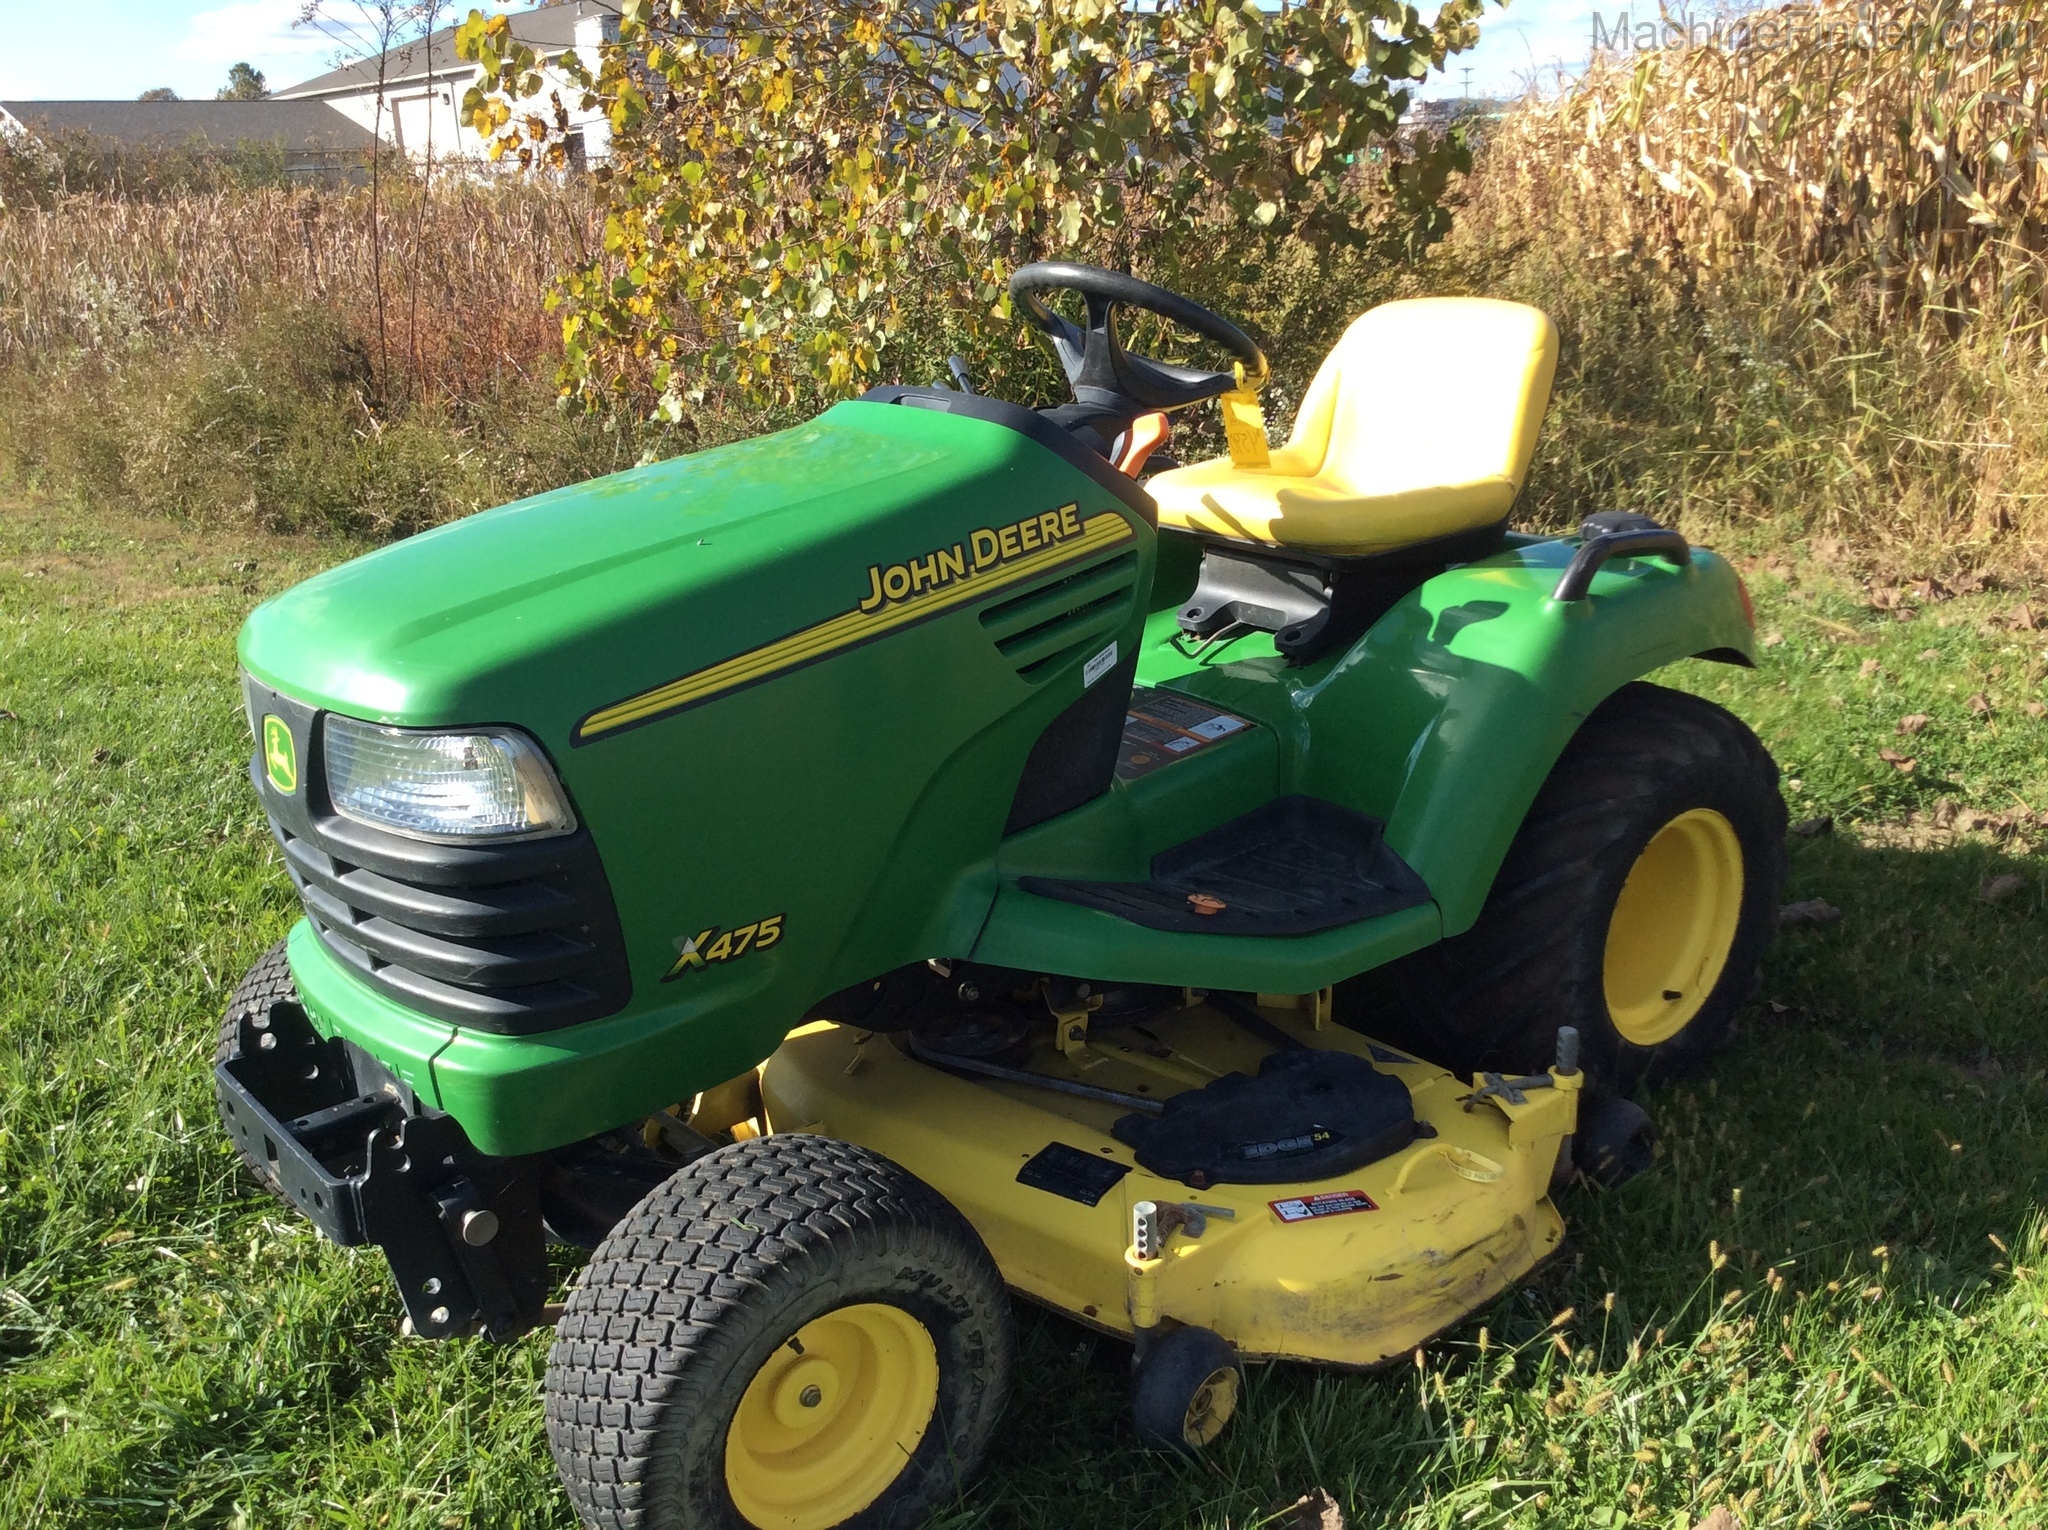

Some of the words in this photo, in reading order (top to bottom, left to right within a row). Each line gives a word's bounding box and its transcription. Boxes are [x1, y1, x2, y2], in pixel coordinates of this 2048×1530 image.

[861, 545, 966, 611] JOHN
[970, 503, 1081, 569] DEERE
[662, 914, 785, 981] X475
[1313, 1131, 1331, 1142] 54
